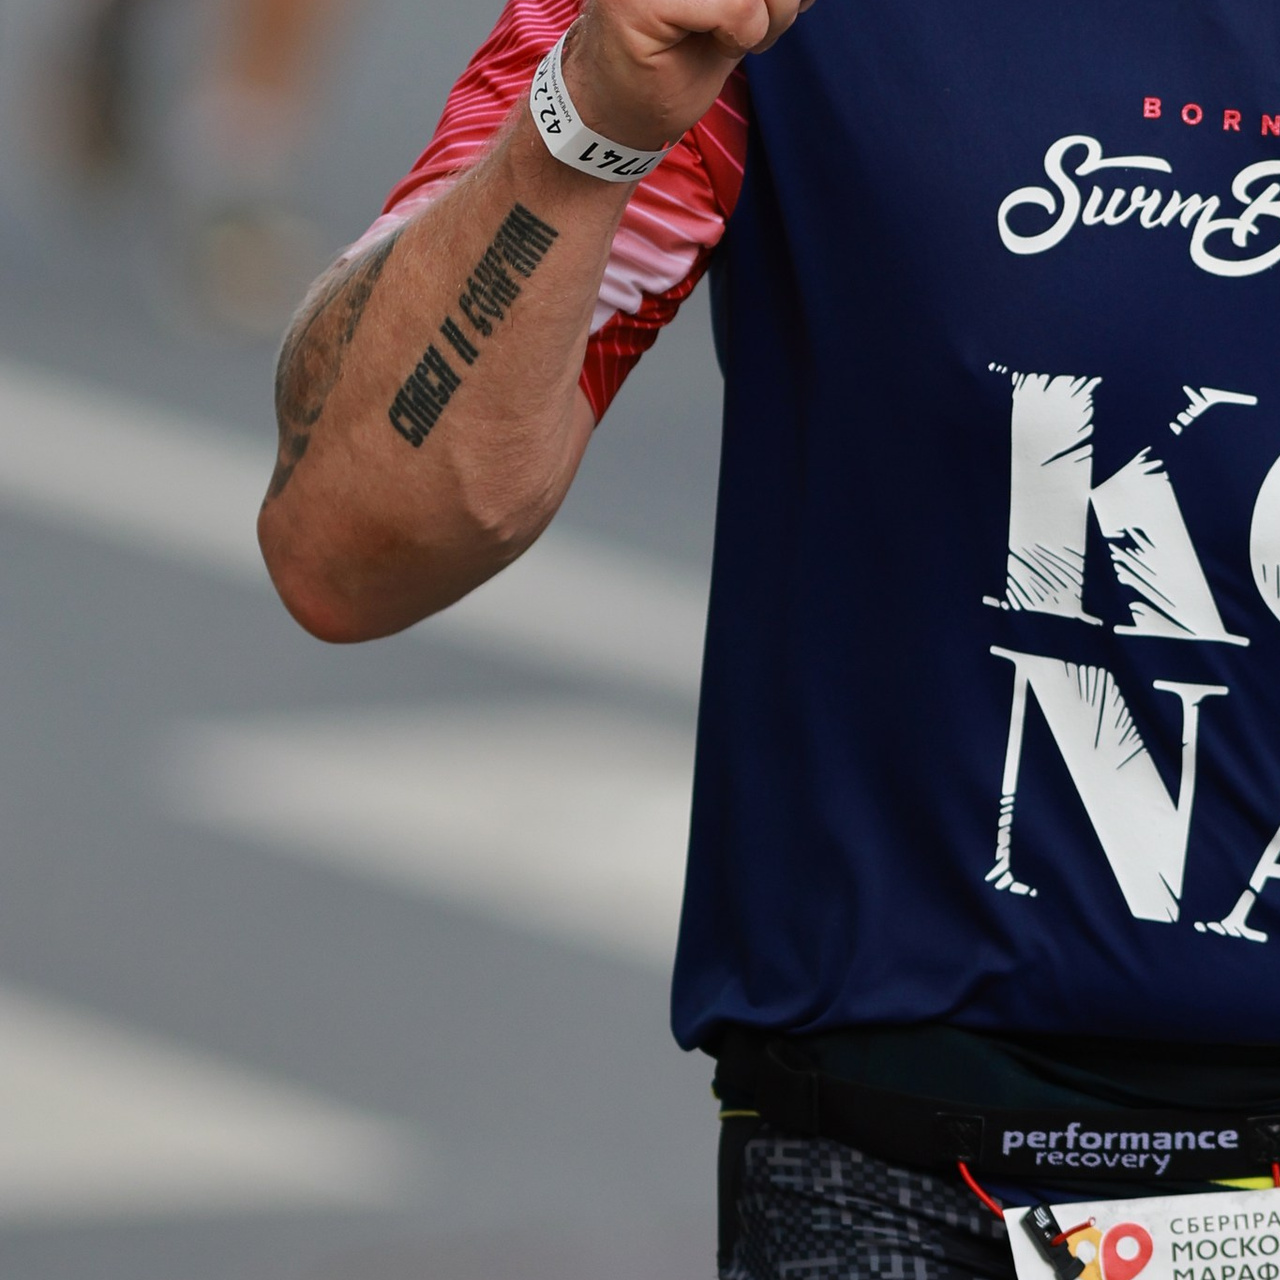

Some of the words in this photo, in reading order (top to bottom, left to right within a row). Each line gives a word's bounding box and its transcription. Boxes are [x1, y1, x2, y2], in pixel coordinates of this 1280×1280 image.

[534, 81, 562, 134] 42,2
[578, 141, 657, 176] 7741
[1001, 1121, 1239, 1156] performance
[1035, 1149, 1172, 1175] recovery
